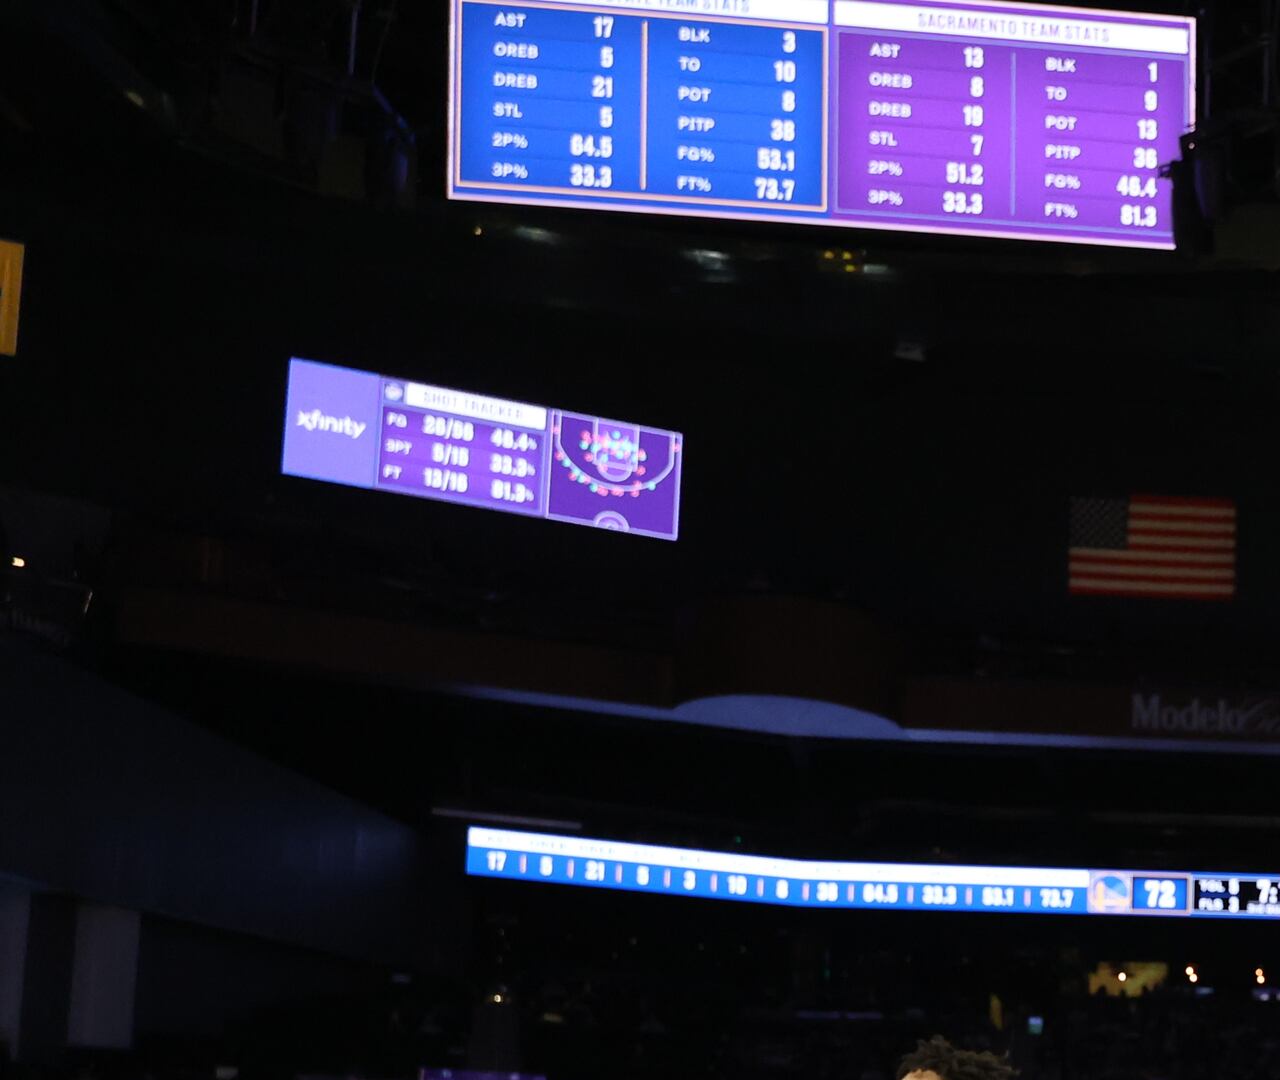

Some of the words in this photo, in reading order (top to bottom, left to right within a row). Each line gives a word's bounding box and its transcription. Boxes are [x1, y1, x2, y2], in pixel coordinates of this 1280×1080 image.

[494, 12, 526, 28] AST
[593, 16, 614, 39] 17
[917, 12, 1017, 36] SACRAMENTO
[1023, 22, 1062, 40] TEAM
[1064, 25, 1110, 43] STATS
[678, 27, 710, 43] BLK
[782, 31, 796, 53] 3
[493, 42, 539, 60] OREB
[601, 46, 614, 68] 5
[869, 43, 901, 59] AST
[963, 47, 985, 69] 13
[678, 57, 700, 72] TO
[773, 60, 796, 83] 10
[869, 72, 913, 89] OREB
[1045, 57, 1077, 74] BLK
[1148, 62, 1158, 84] 1
[493, 72, 538, 89] DREB
[591, 75, 613, 99] 21
[677, 86, 711, 103] POT
[1045, 86, 1067, 102] TO
[493, 102, 522, 119] STL
[600, 106, 613, 128] 5
[868, 102, 912, 119] DREB
[677, 116, 715, 133] PITP
[1045, 116, 1077, 132] POT
[1136, 119, 1158, 141] 13
[491, 132, 528, 149] 2P%
[868, 131, 898, 147] STL
[971, 135, 984, 156] 7
[1045, 145, 1081, 161] PITP
[677, 146, 715, 163] FG%
[756, 148, 796, 172] 53.1
[491, 162, 528, 179] 3P%
[569, 164, 613, 188] 33.3
[867, 160, 903, 177] 2P%
[945, 162, 984, 186] 51.2
[1044, 174, 1081, 191] FG%
[676, 175, 712, 193] FT%
[754, 177, 796, 201] 73.7
[867, 189, 903, 207] 3P%
[942, 191, 984, 216] 33.3
[1044, 203, 1078, 220] FT%
[296, 409, 366, 440] xfinity
[383, 464, 402, 480] FT
[1131, 693, 1245, 734] Modelo
[1143, 879, 1177, 909] 72
